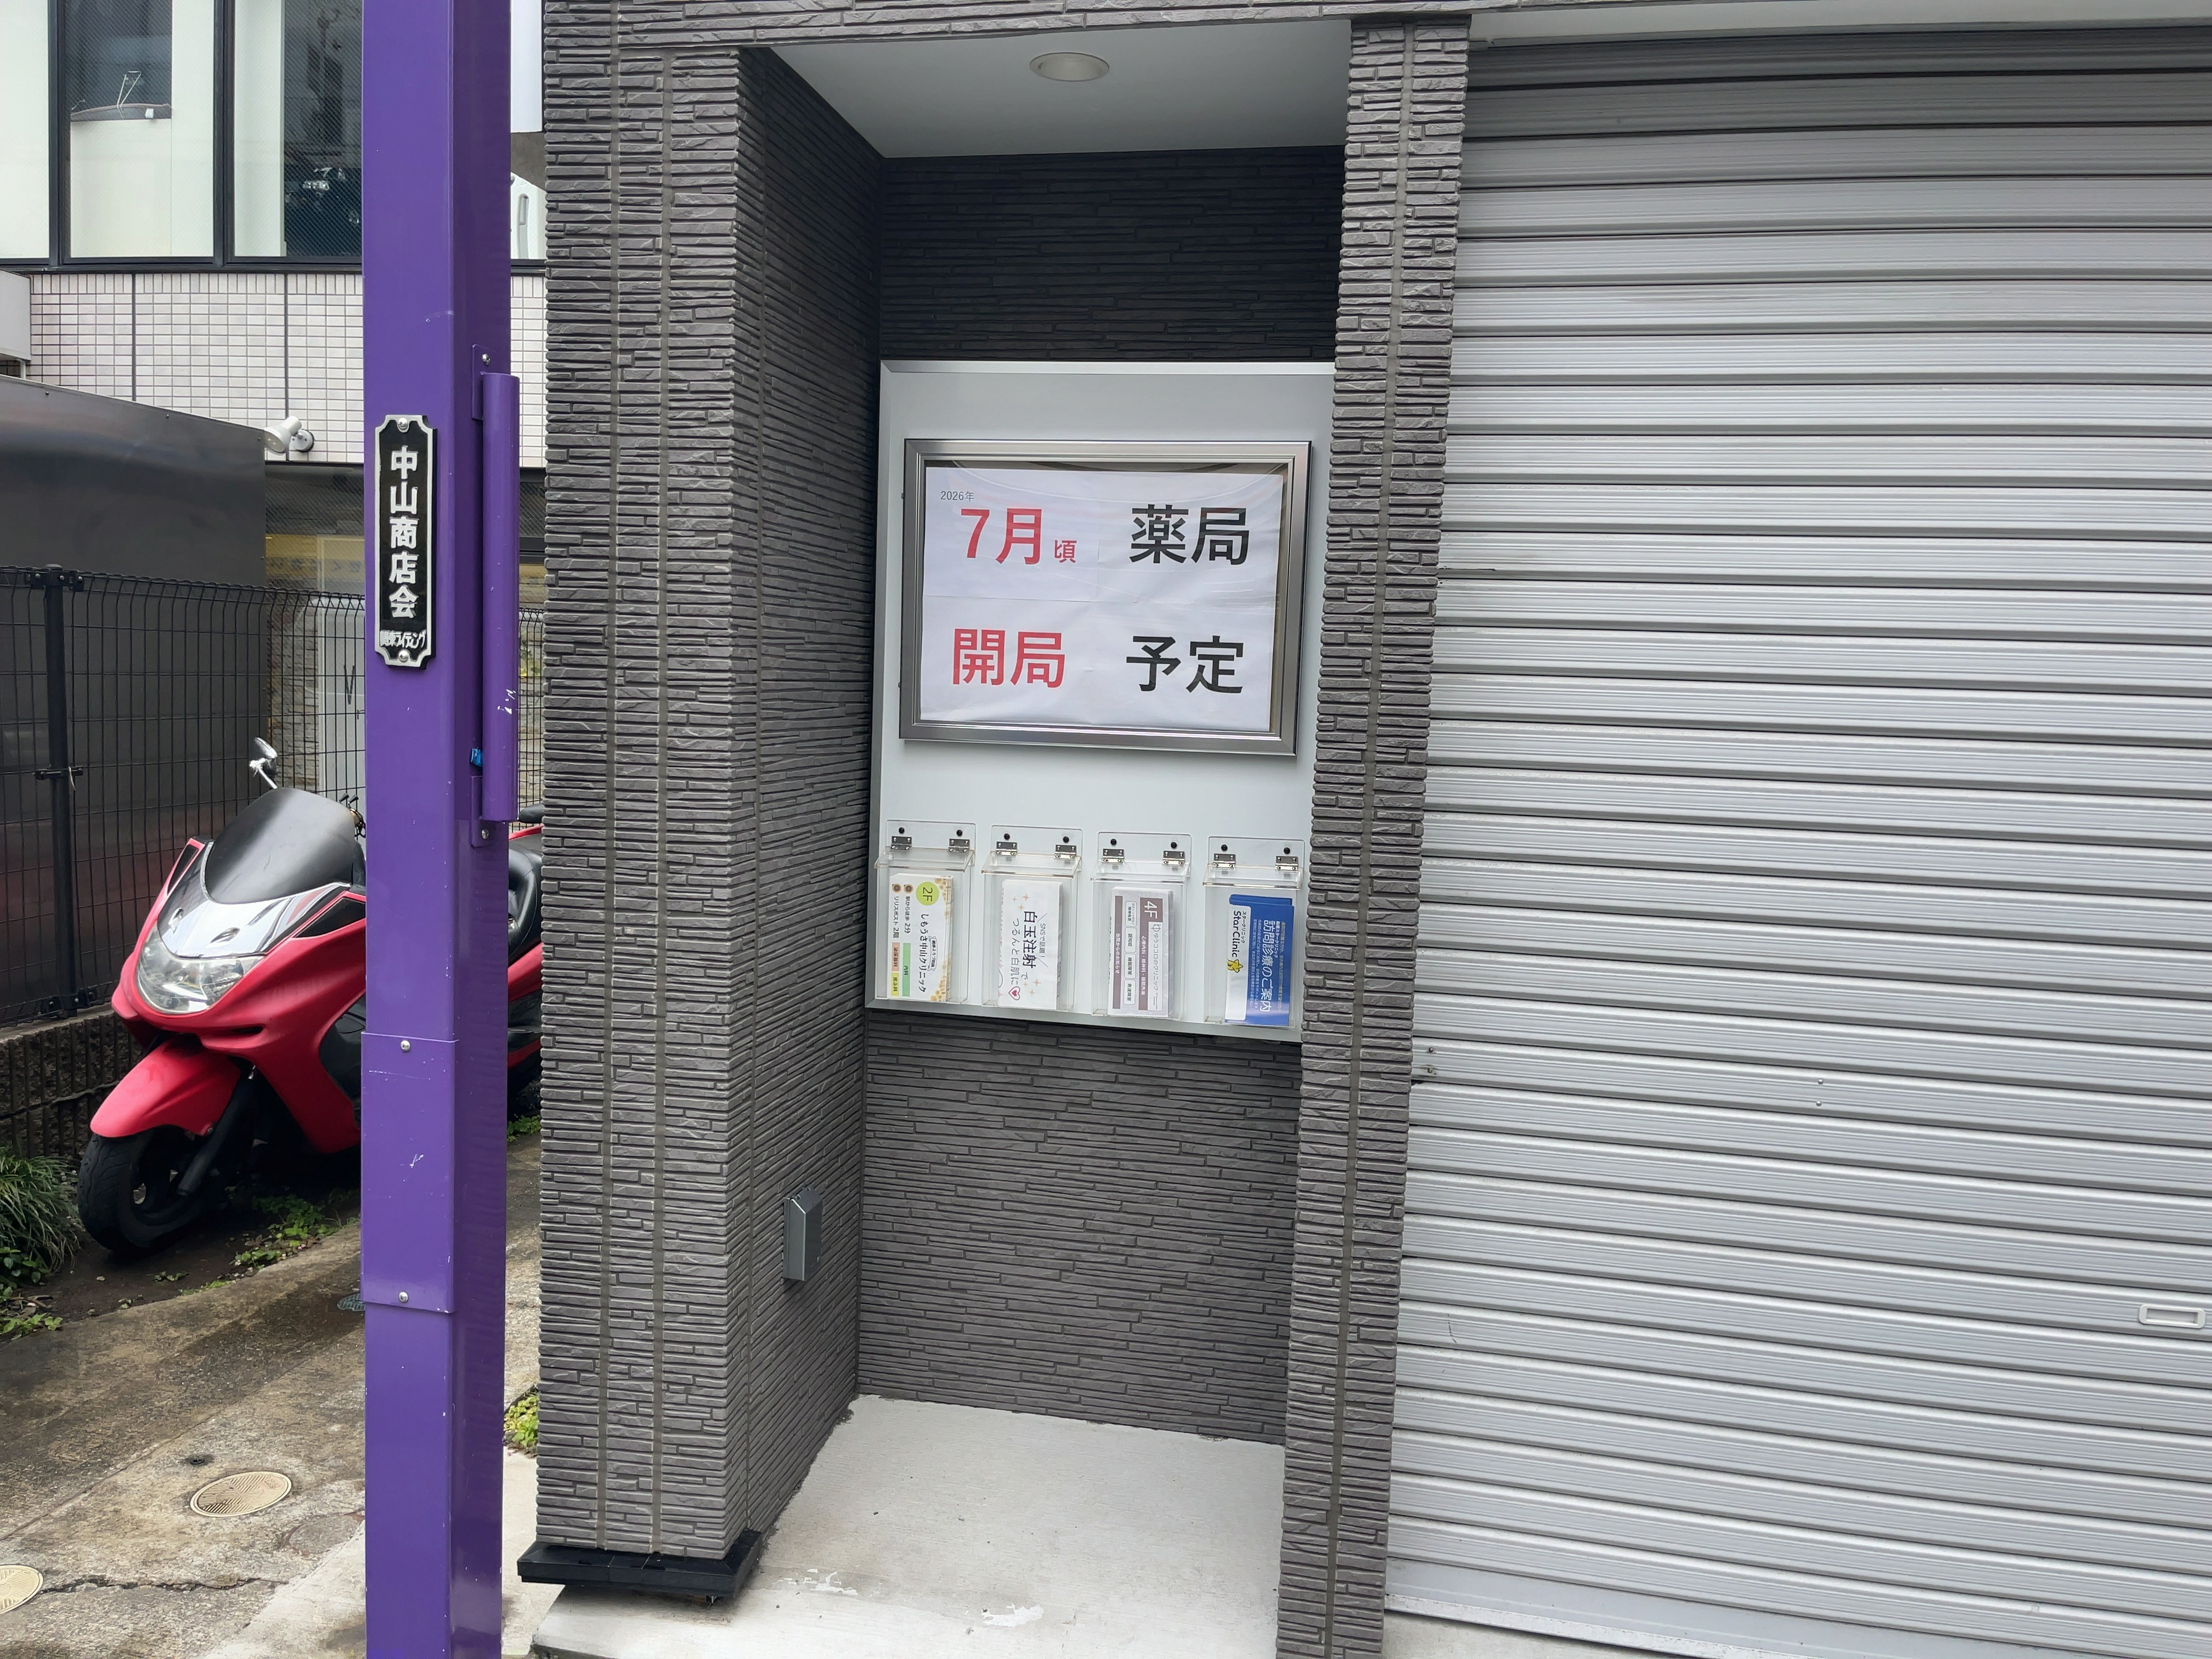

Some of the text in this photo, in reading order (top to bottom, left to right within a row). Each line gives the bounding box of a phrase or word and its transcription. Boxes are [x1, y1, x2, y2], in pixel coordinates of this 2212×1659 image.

[940, 490, 975, 503] 2026年
[388, 445, 419, 618] 中山商店会
[1128, 504, 1250, 566] 薬局
[952, 628, 1244, 695] 開局 予定
[922, 887, 933, 902] 2F
[1144, 900, 1158, 919] 4F
[918, 913, 929, 993] しもうさ中山クリニック
[1010, 918, 1020, 985] つるんと白肌に
[1260, 919, 1276, 1012] 訪問診療のご案内
